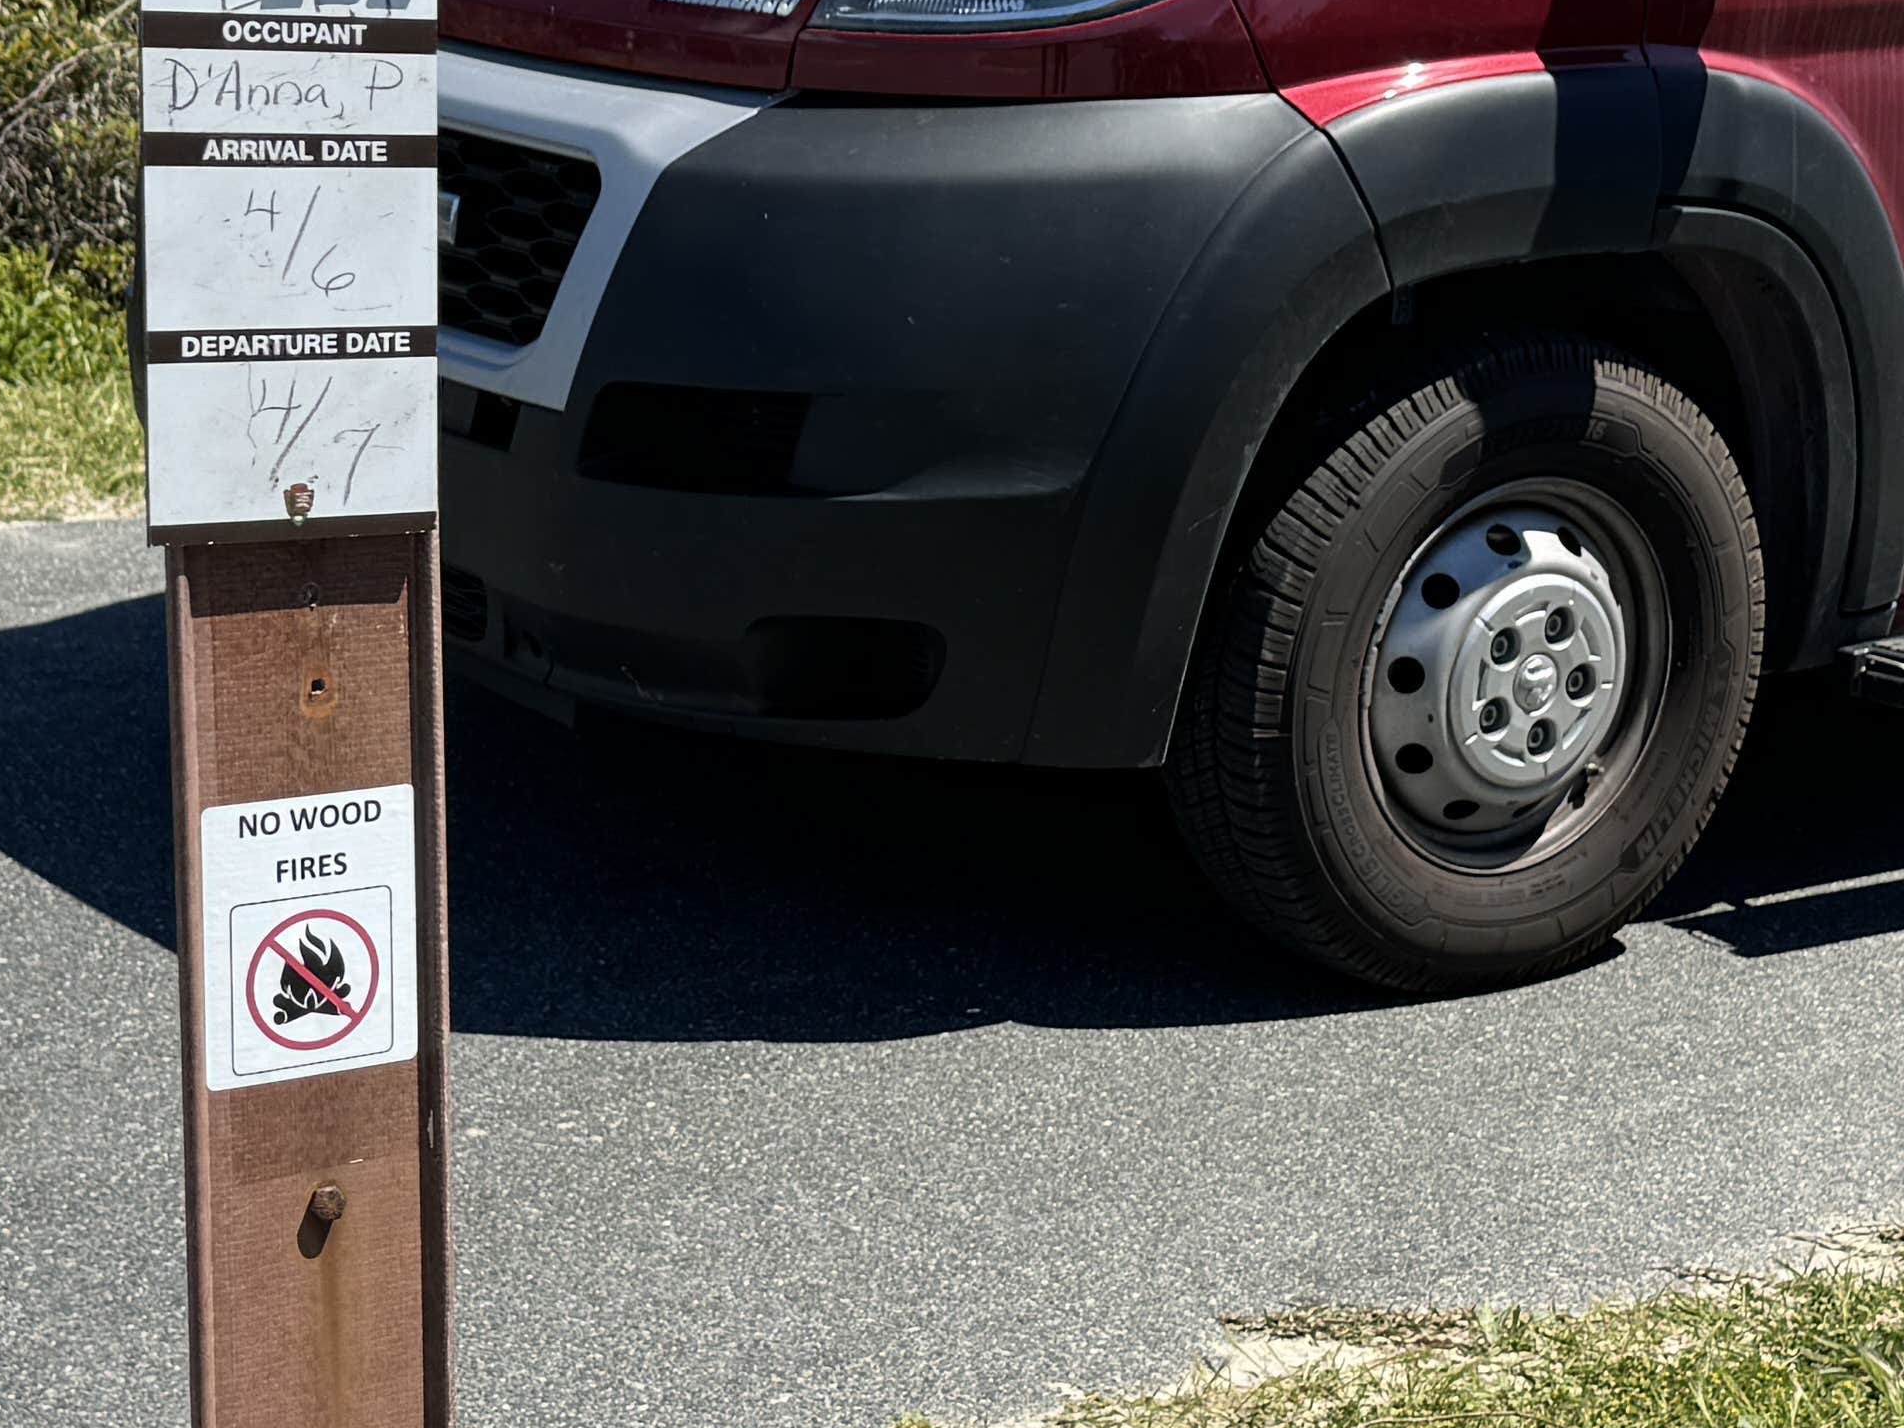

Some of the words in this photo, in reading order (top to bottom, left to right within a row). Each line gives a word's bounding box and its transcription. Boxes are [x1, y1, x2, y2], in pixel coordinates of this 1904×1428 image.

[222, 19, 368, 46] OCCUPANT
[364, 58, 404, 111] P
[202, 138, 314, 163] ARRIVAL
[321, 139, 388, 163] DATE
[243, 184, 356, 297] 4/6
[181, 333, 338, 358] DEPARTURE
[346, 331, 411, 355] DATE
[250, 376, 382, 506] 4/7
[238, 810, 281, 839] NO
[289, 798, 382, 832] WOOD
[275, 851, 348, 884] FIRES
